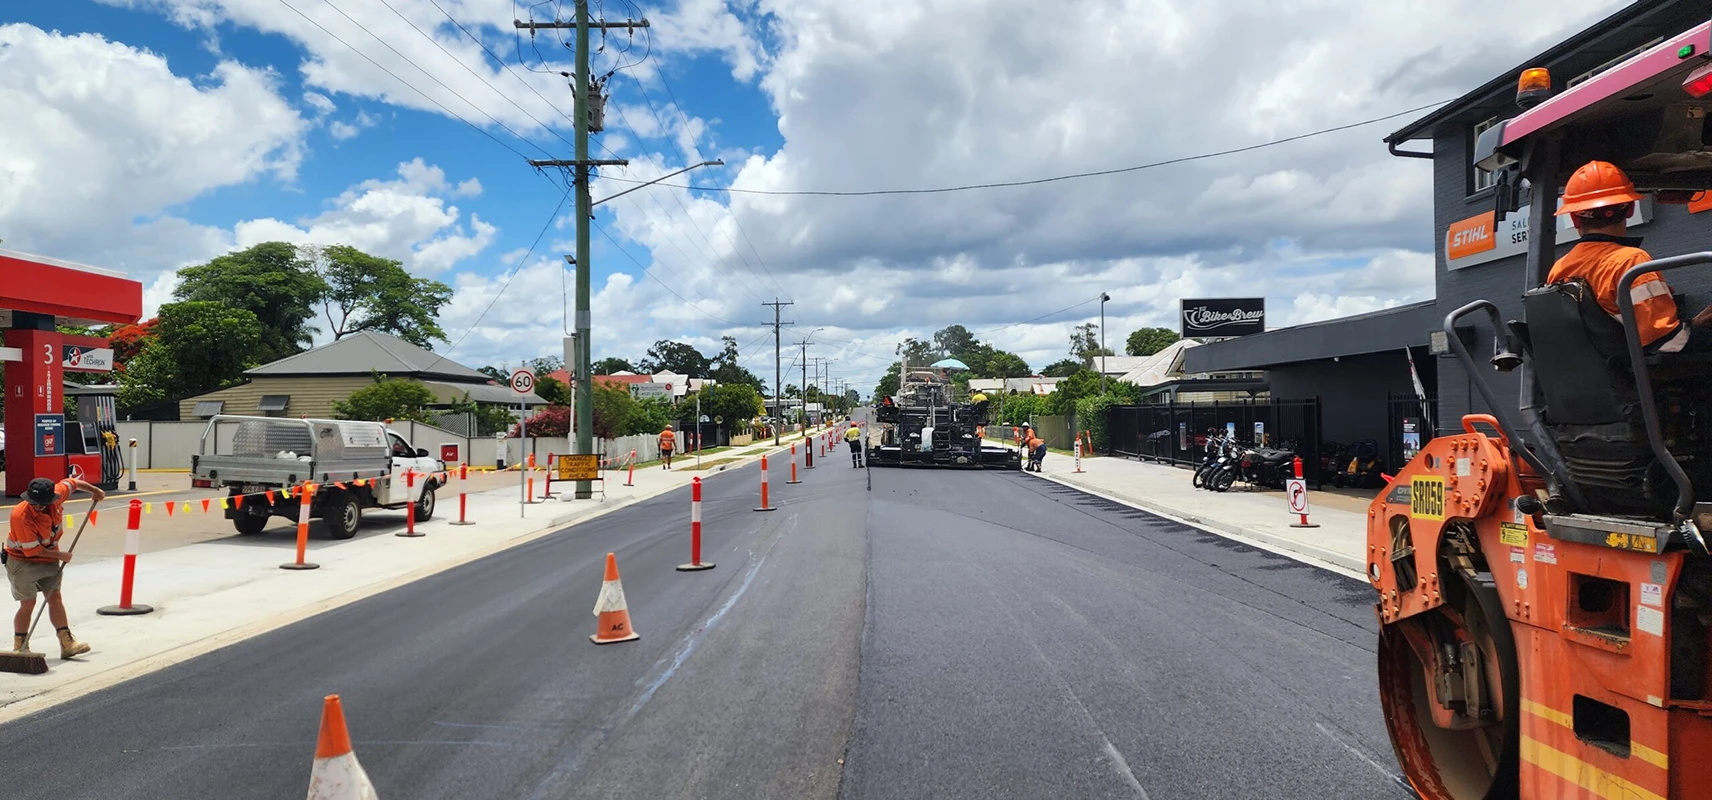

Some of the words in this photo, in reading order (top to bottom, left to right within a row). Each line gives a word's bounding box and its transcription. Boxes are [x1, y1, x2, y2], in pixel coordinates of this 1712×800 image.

[1512, 217, 1529, 230] SAL
[1453, 225, 1488, 247] STIHL
[44, 344, 53, 364] 3
[515, 376, 530, 387] 60
[1413, 480, 1443, 516] SR059
